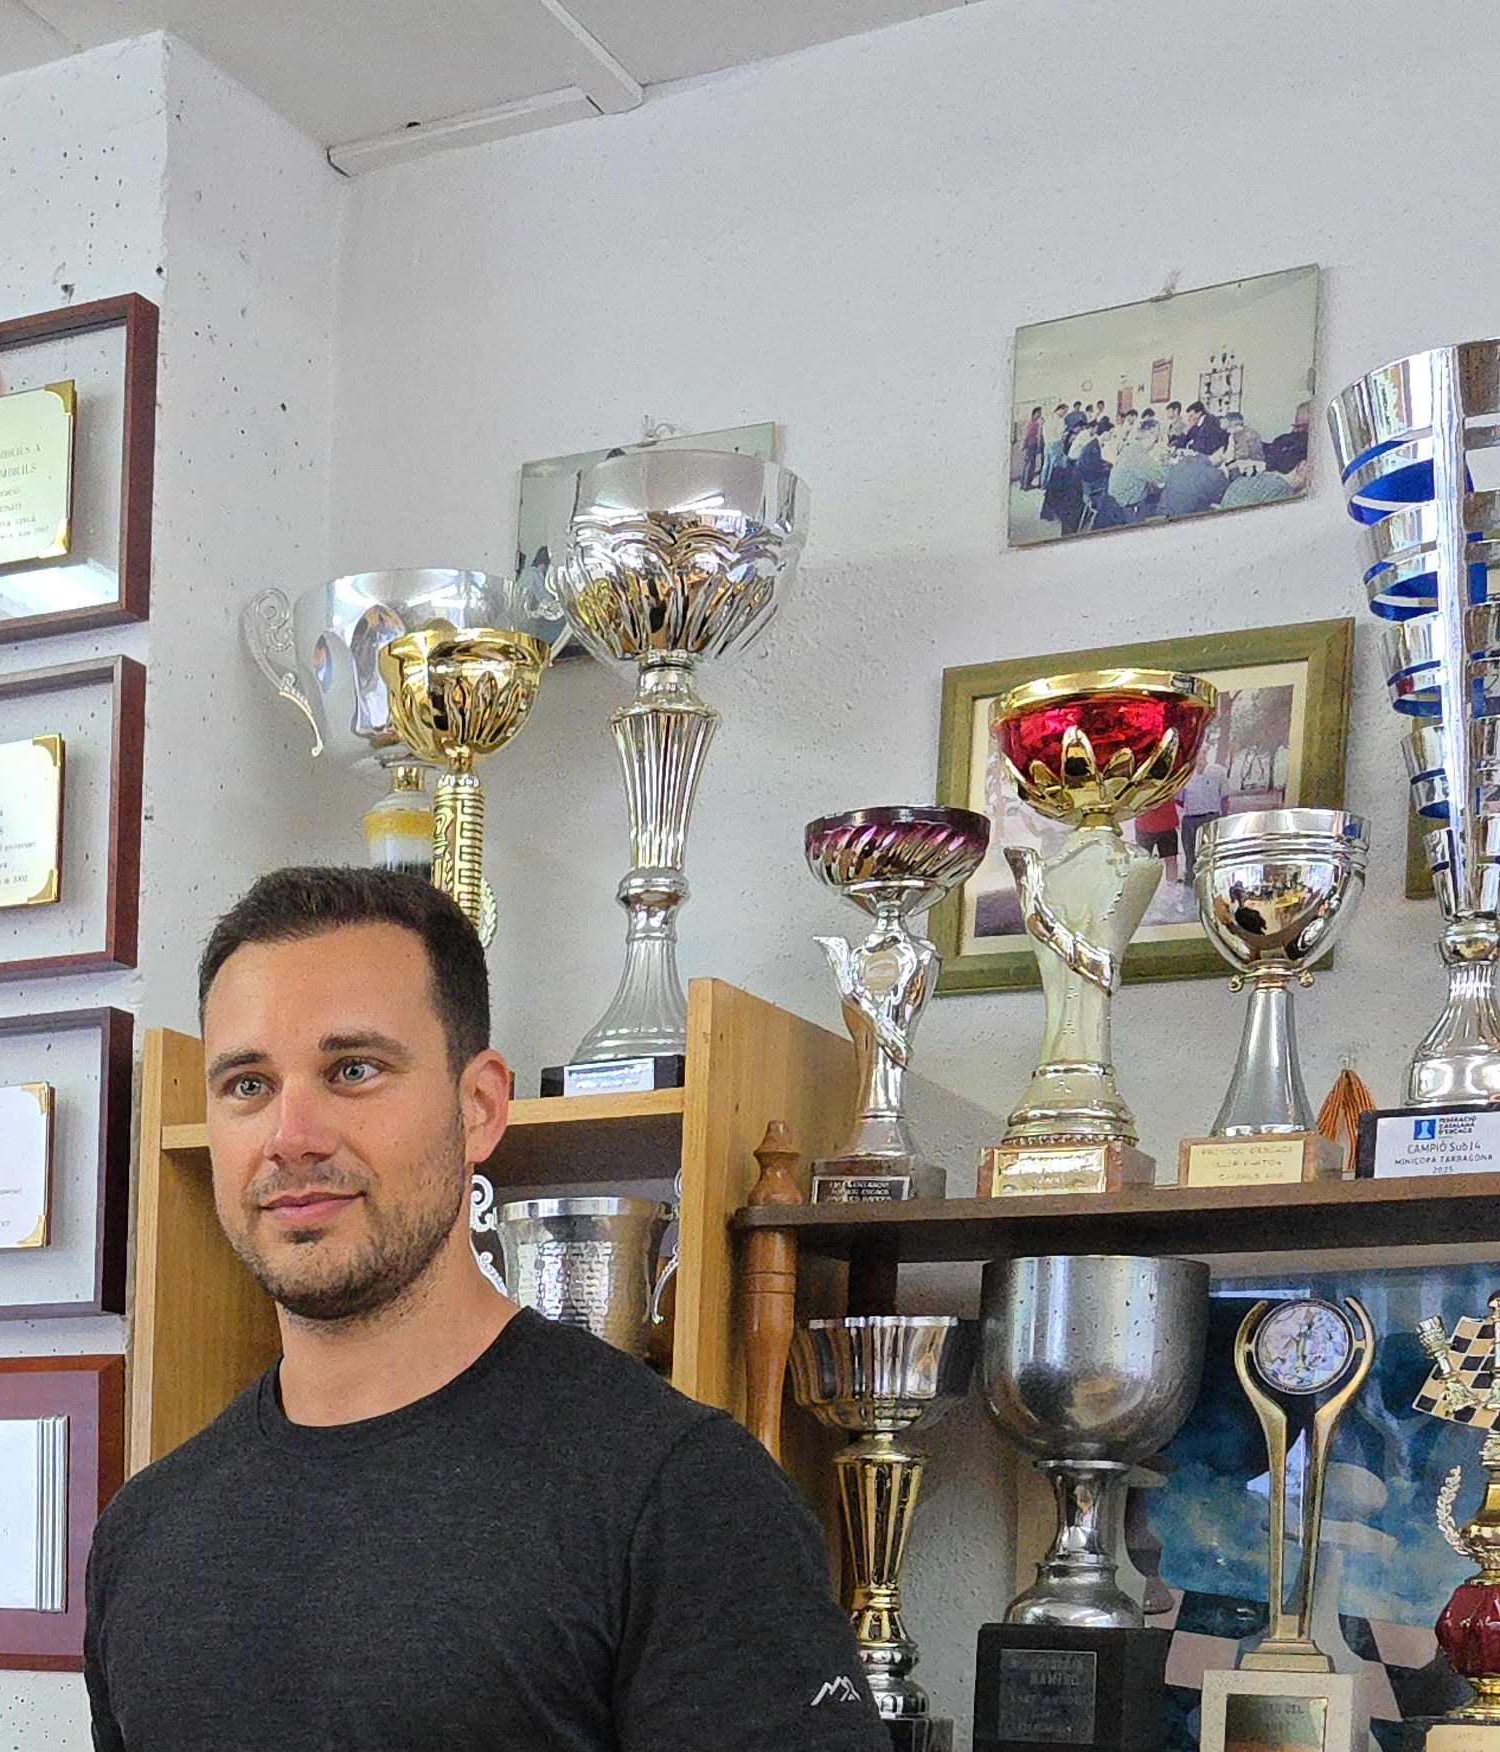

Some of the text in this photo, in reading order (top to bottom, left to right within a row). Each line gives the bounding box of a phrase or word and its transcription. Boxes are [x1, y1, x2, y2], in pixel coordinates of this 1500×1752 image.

[1407, 1138, 1447, 1155] CAMPIÓ
[1395, 1153, 1493, 1166] MINICOPA TARRAGONA
